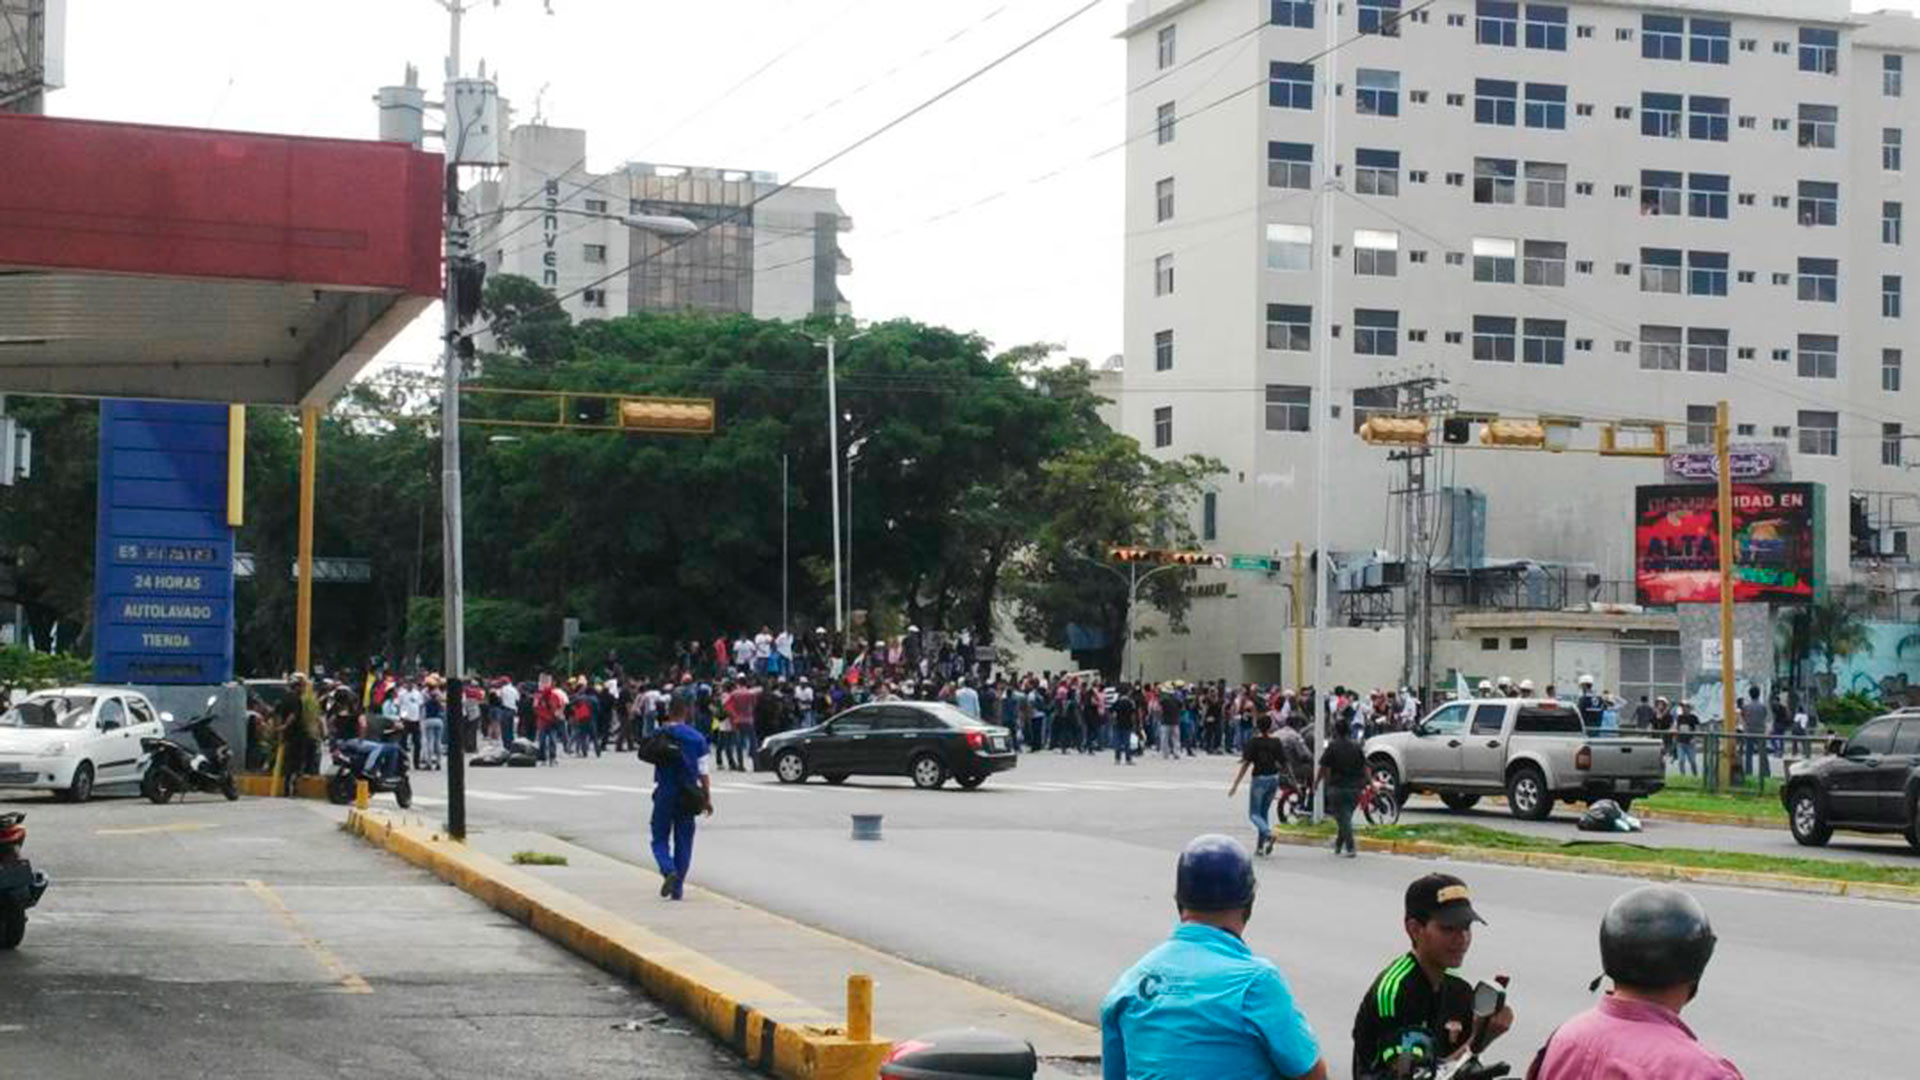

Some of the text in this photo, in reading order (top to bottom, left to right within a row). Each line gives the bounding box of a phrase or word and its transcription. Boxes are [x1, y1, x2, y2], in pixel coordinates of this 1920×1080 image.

[1733, 496, 1775, 508] IDAD
[1780, 493, 1804, 507] EN
[134, 574, 201, 590] 24 HORAS
[123, 603, 212, 619] AUTOLAVADO
[141, 632, 191, 647] TIENDA
